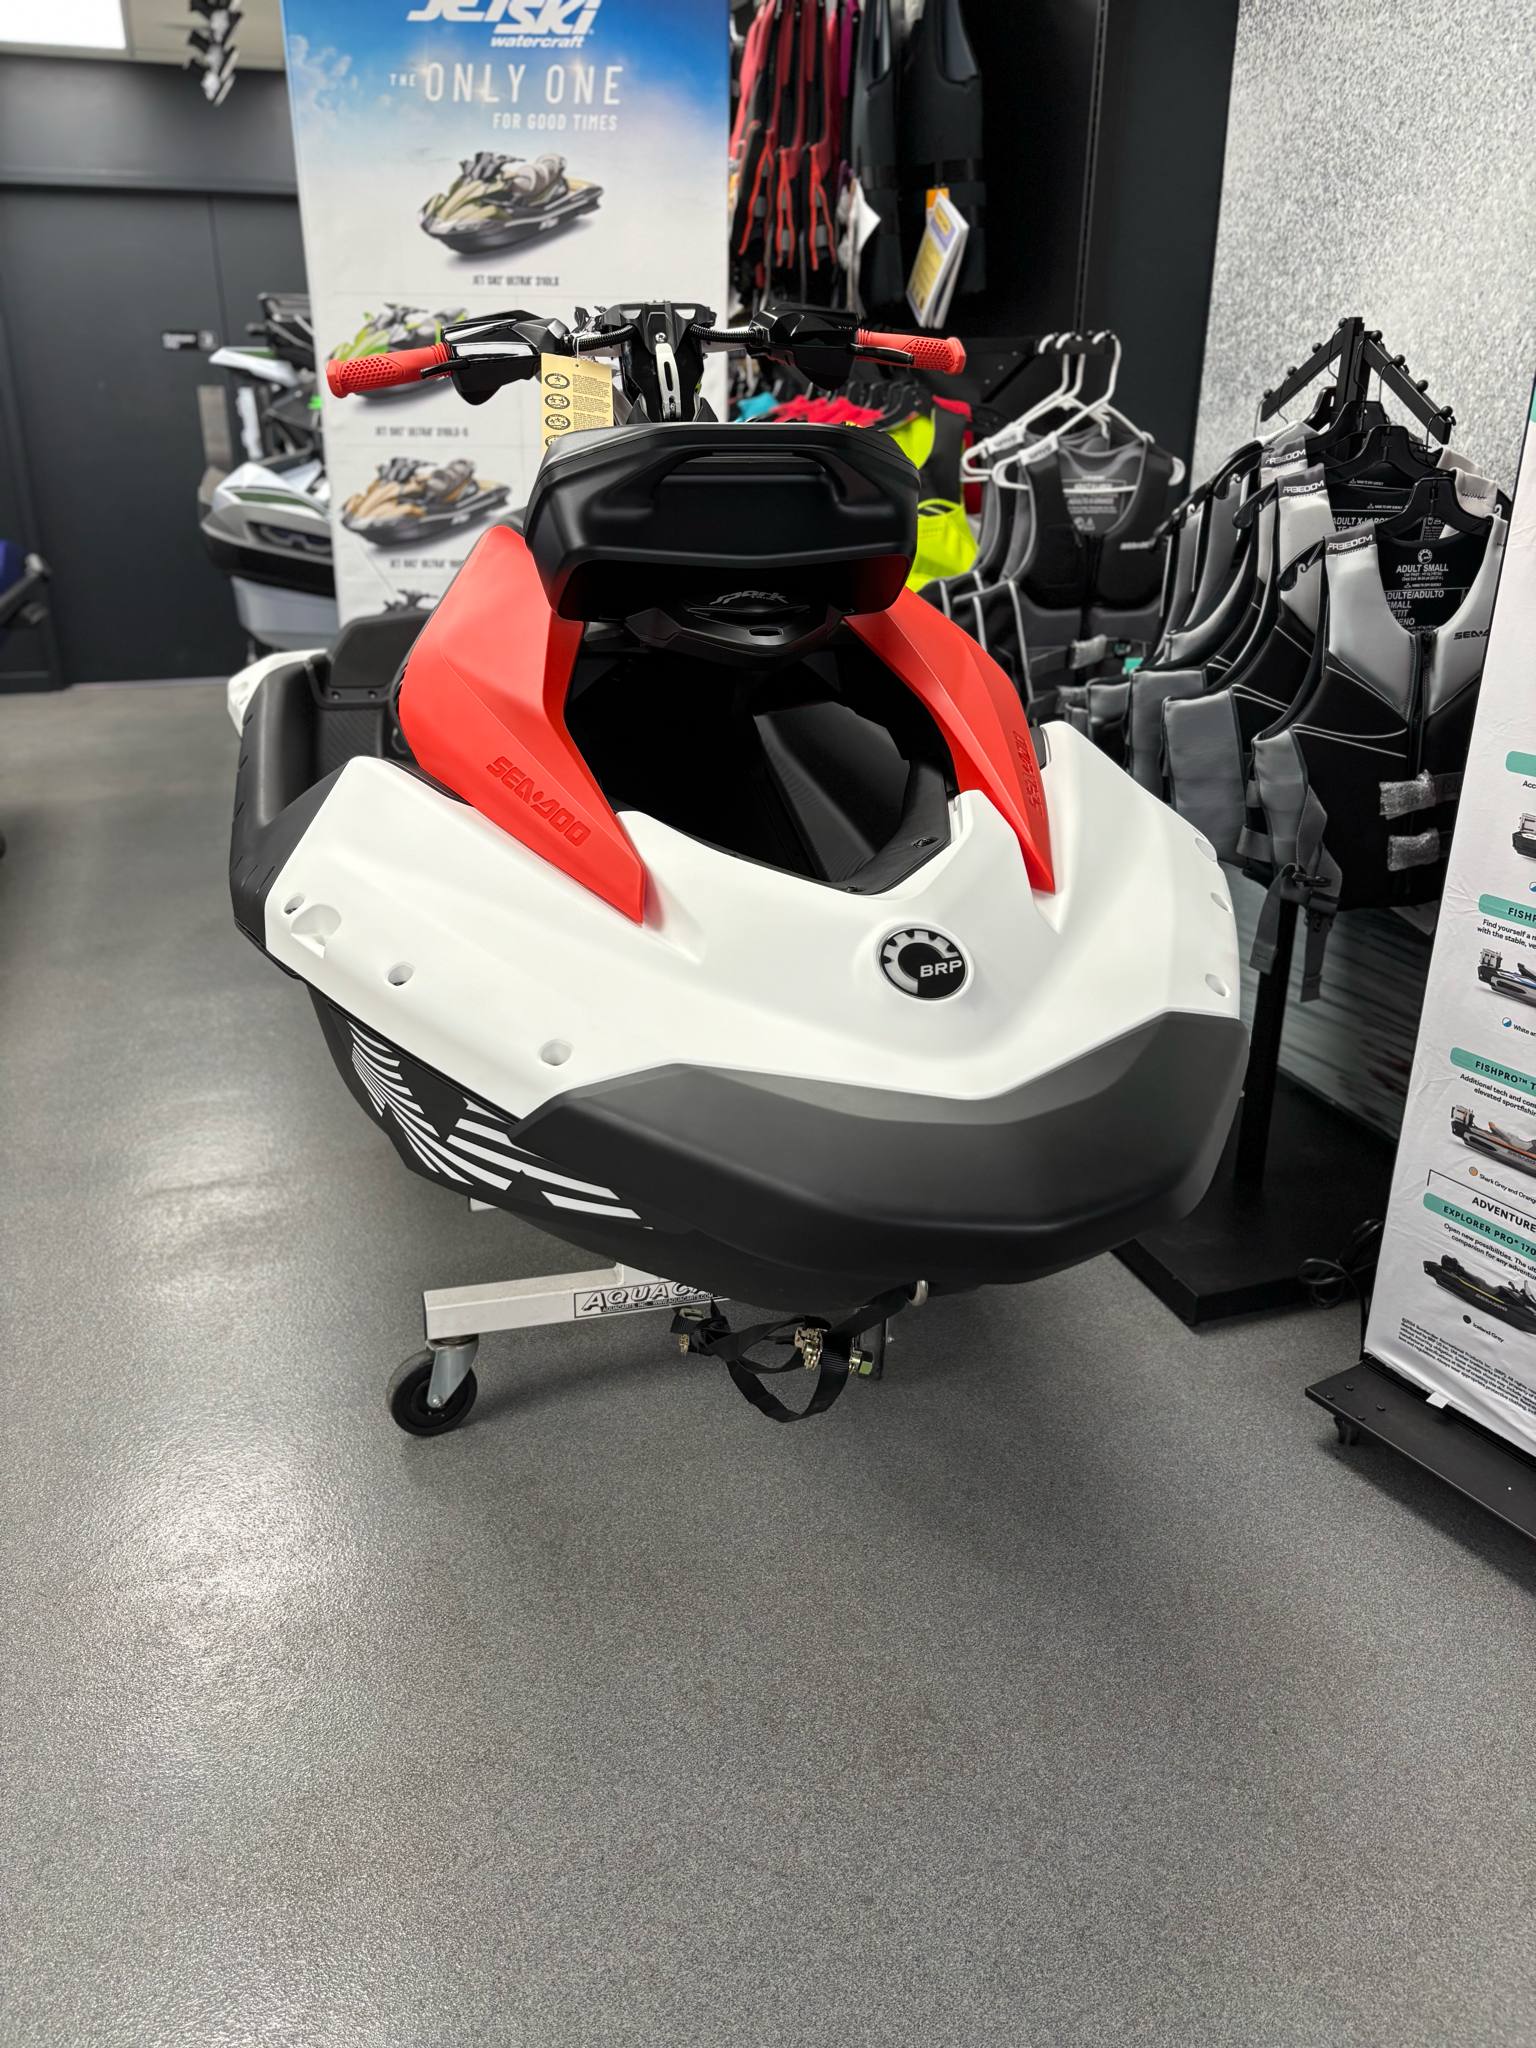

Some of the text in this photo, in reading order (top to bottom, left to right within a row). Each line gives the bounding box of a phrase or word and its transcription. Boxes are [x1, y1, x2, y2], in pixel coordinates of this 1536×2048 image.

[490, 35, 584, 48] watercraft
[390, 62, 623, 105] THE ONLY ONE
[492, 113, 618, 131] FOR GOOD TIMES
[1265, 448, 1306, 464] FREEDOM
[1283, 480, 1325, 494] FREEDOM
[1327, 534, 1373, 550] FREEDOM
[1396, 563, 1448, 573] ADULT SMALL
[1384, 590, 1445, 600] DULTE/ADULTO
[1482, 919, 1497, 929] Find
[1498, 925, 1526, 937] yourself
[1477, 927, 1491, 936] with
[1492, 931, 1503, 939] the
[1505, 935, 1527, 947] stable,
[920, 960, 962, 978] BRP
[1513, 1024, 1529, 1034] White
[1460, 1074, 1492, 1090] Additional
[1494, 1086, 1508, 1097] tech
[1509, 1094, 1521, 1102] and
[1474, 1088, 1501, 1102] elevated
[1494, 1181, 1507, 1191] Grey
[1443, 1206, 1490, 1233] EXPLORER
[1472, 1197, 1536, 1232] ADVENTURE
[1444, 1223, 1460, 1236] Open
[1461, 1233, 1474, 1241] new
[1475, 1239, 1512, 1261] possibilities.
[1514, 1256, 1526, 1267] The
[1452, 1235, 1485, 1254] companion
[1486, 1250, 1496, 1259] for
[1491, 1332, 1504, 1343] Grey
